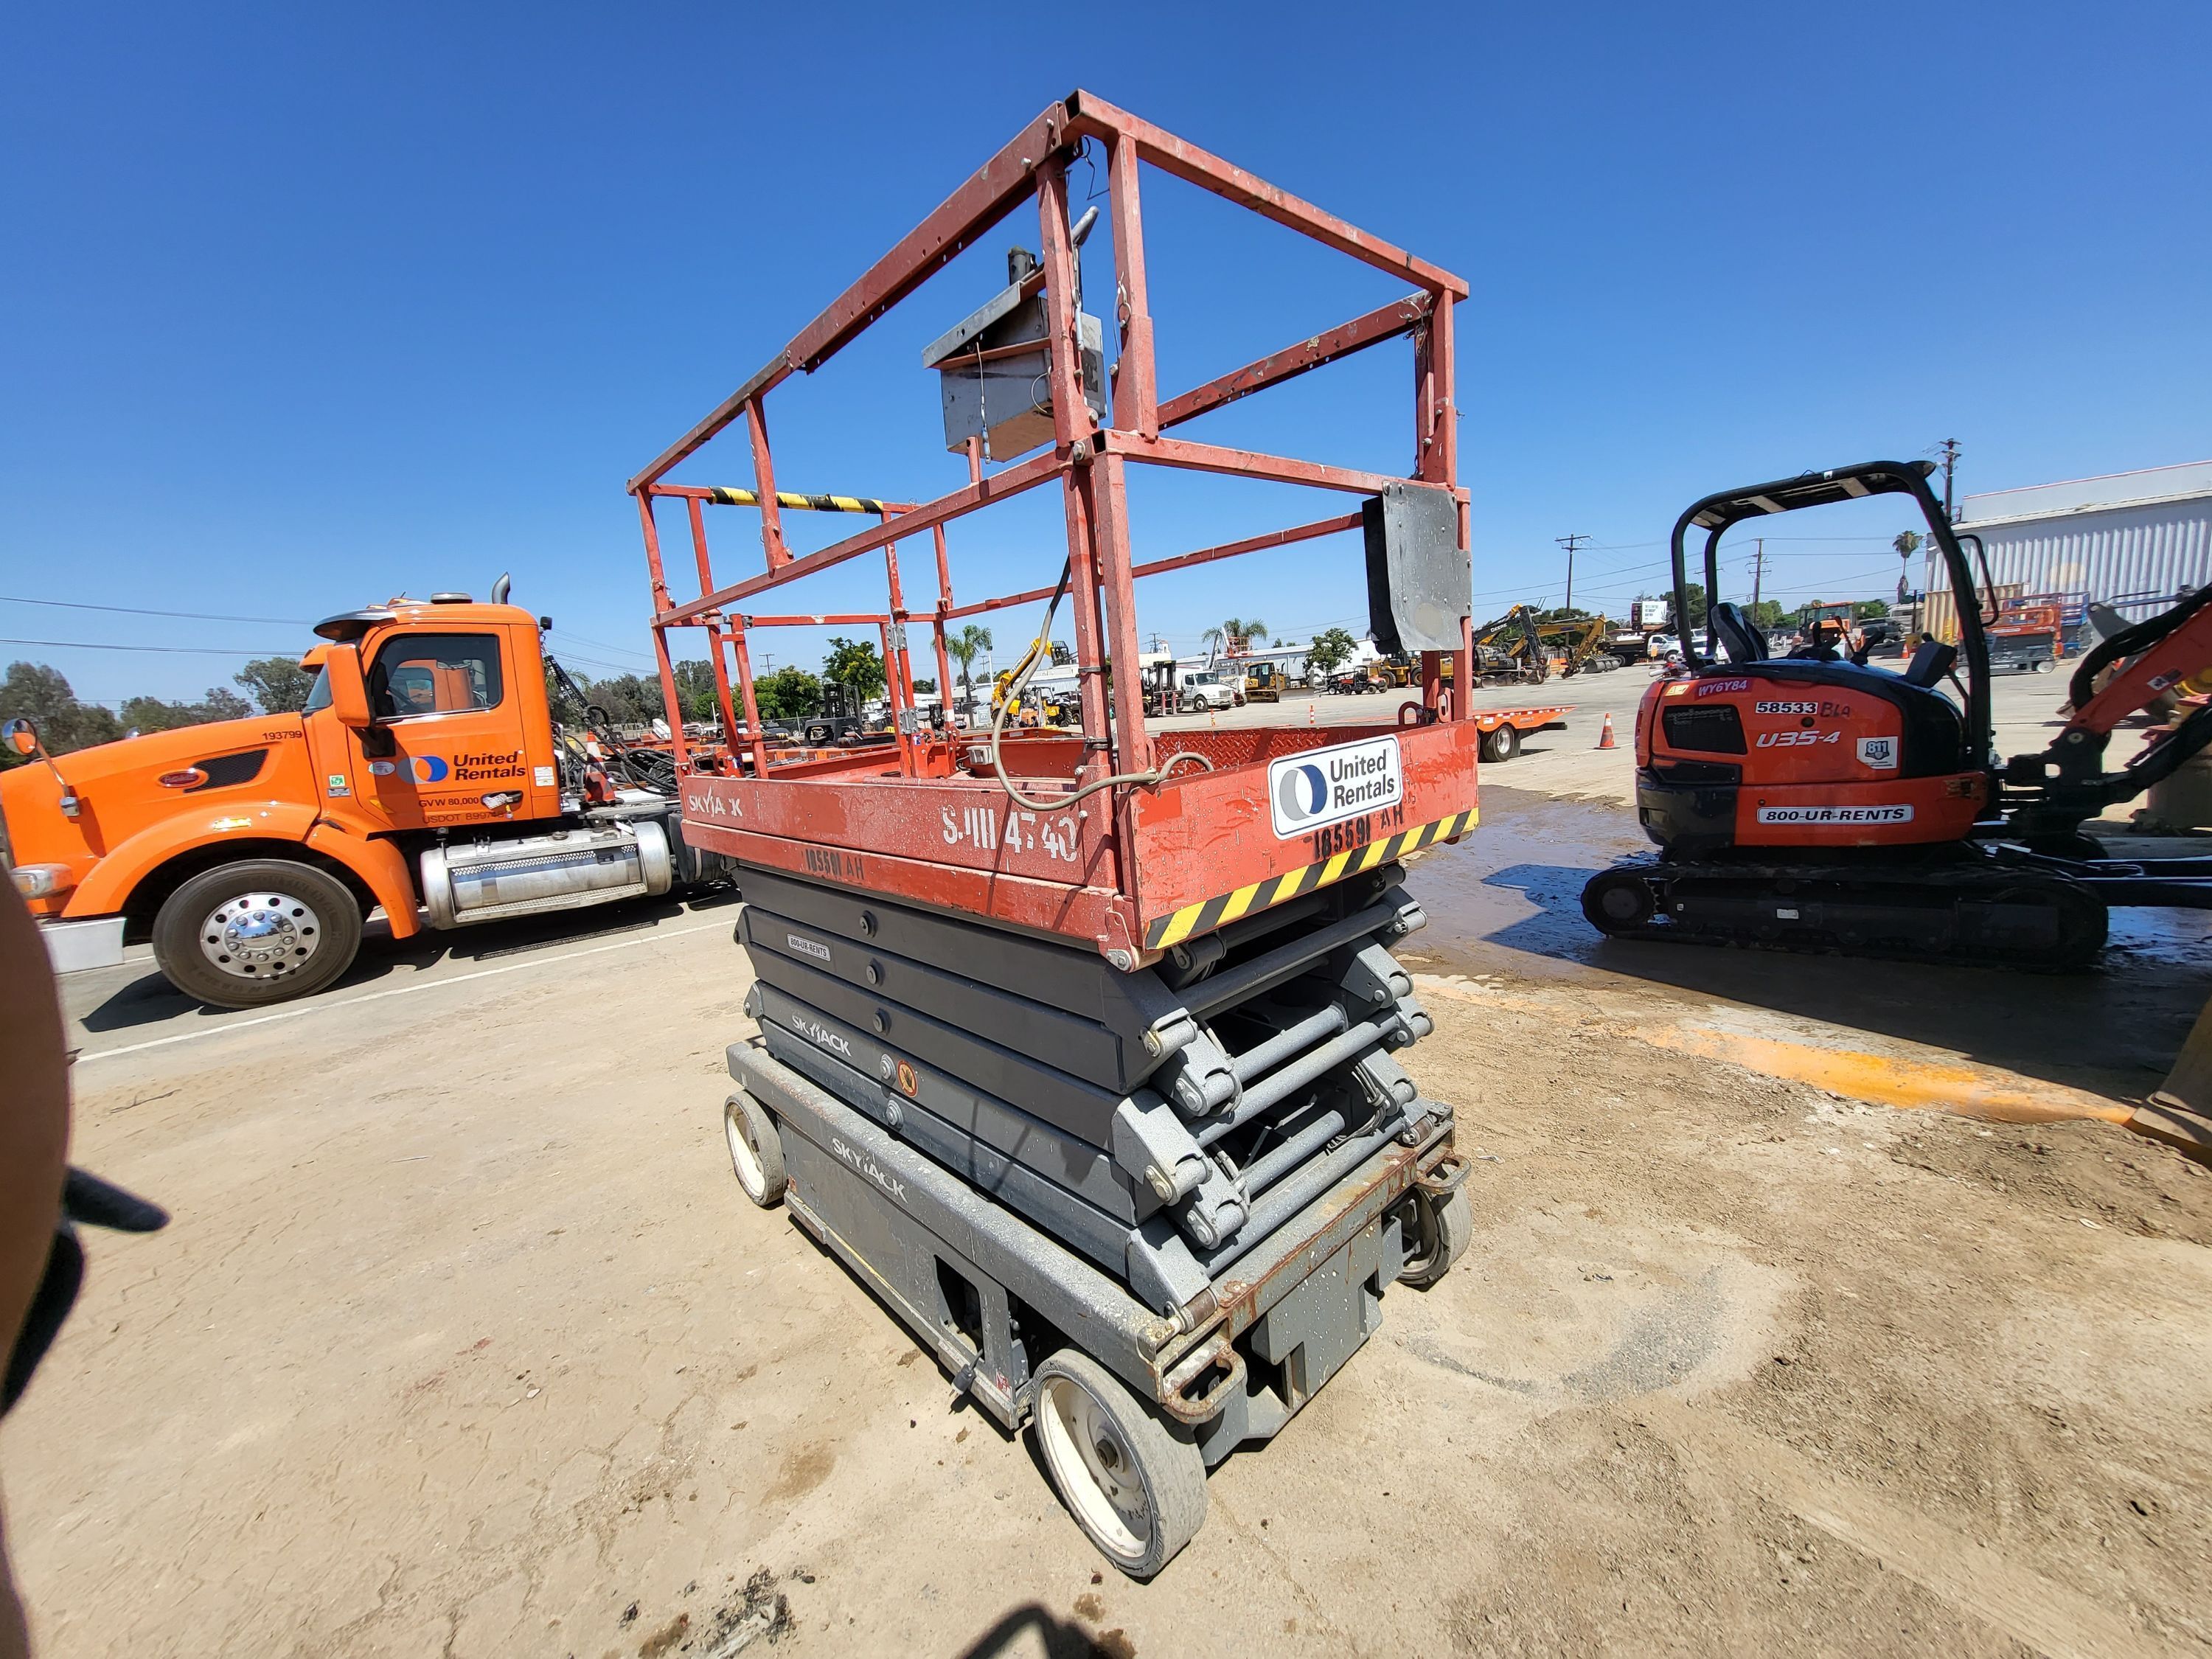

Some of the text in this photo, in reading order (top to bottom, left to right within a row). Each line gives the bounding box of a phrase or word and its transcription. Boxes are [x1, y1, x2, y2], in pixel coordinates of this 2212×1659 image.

[1490, 623, 1508, 633] DEERE
[1698, 680, 1747, 697] WY6Y84
[1757, 703, 1817, 713] 58533
[262, 730, 302, 740] 193799
[1756, 730, 1841, 748] U35-4
[1867, 742, 1888, 753] 811
[454, 751, 518, 767] United
[1330, 748, 1388, 782] United
[455, 767, 526, 781] Rentals
[1334, 774, 1394, 809] Rentals
[419, 799, 445, 807] GVW
[448, 797, 479, 806] 80,000
[689, 785, 742, 817] SKYJAK
[422, 813, 460, 824] USDOT
[1766, 808, 1905, 821] 800-UR-RENTS
[846, 855, 864, 880] AH
[790, 937, 827, 956] 800-UR-RENTS
[792, 1015, 852, 1057] SKYJACK
